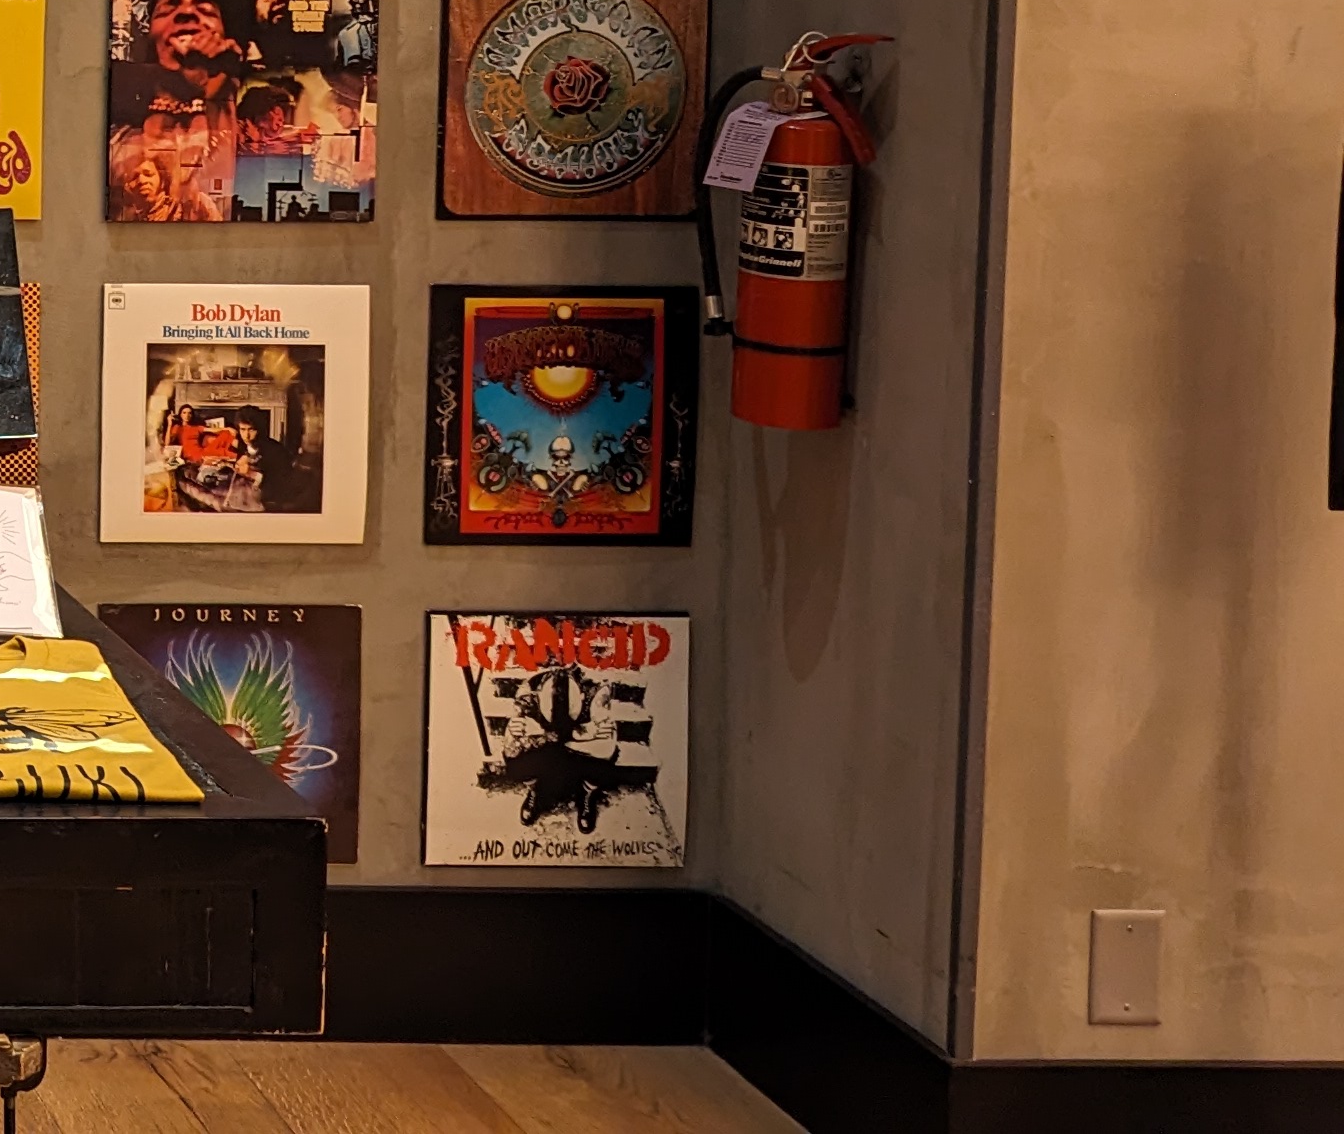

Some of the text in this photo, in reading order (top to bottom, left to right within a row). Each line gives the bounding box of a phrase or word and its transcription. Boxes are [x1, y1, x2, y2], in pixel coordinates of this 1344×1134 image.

[191, 304, 281, 325] Bob Dylan
[162, 325, 310, 340] Bringing It All Back Home
[154, 608, 305, 622] JOURNEY
[455, 617, 671, 672] RANCID
[513, 840, 541, 860] OUT
[545, 840, 579, 859] COME
[585, 839, 605, 858] THE
[613, 840, 655, 858] WOLVES
